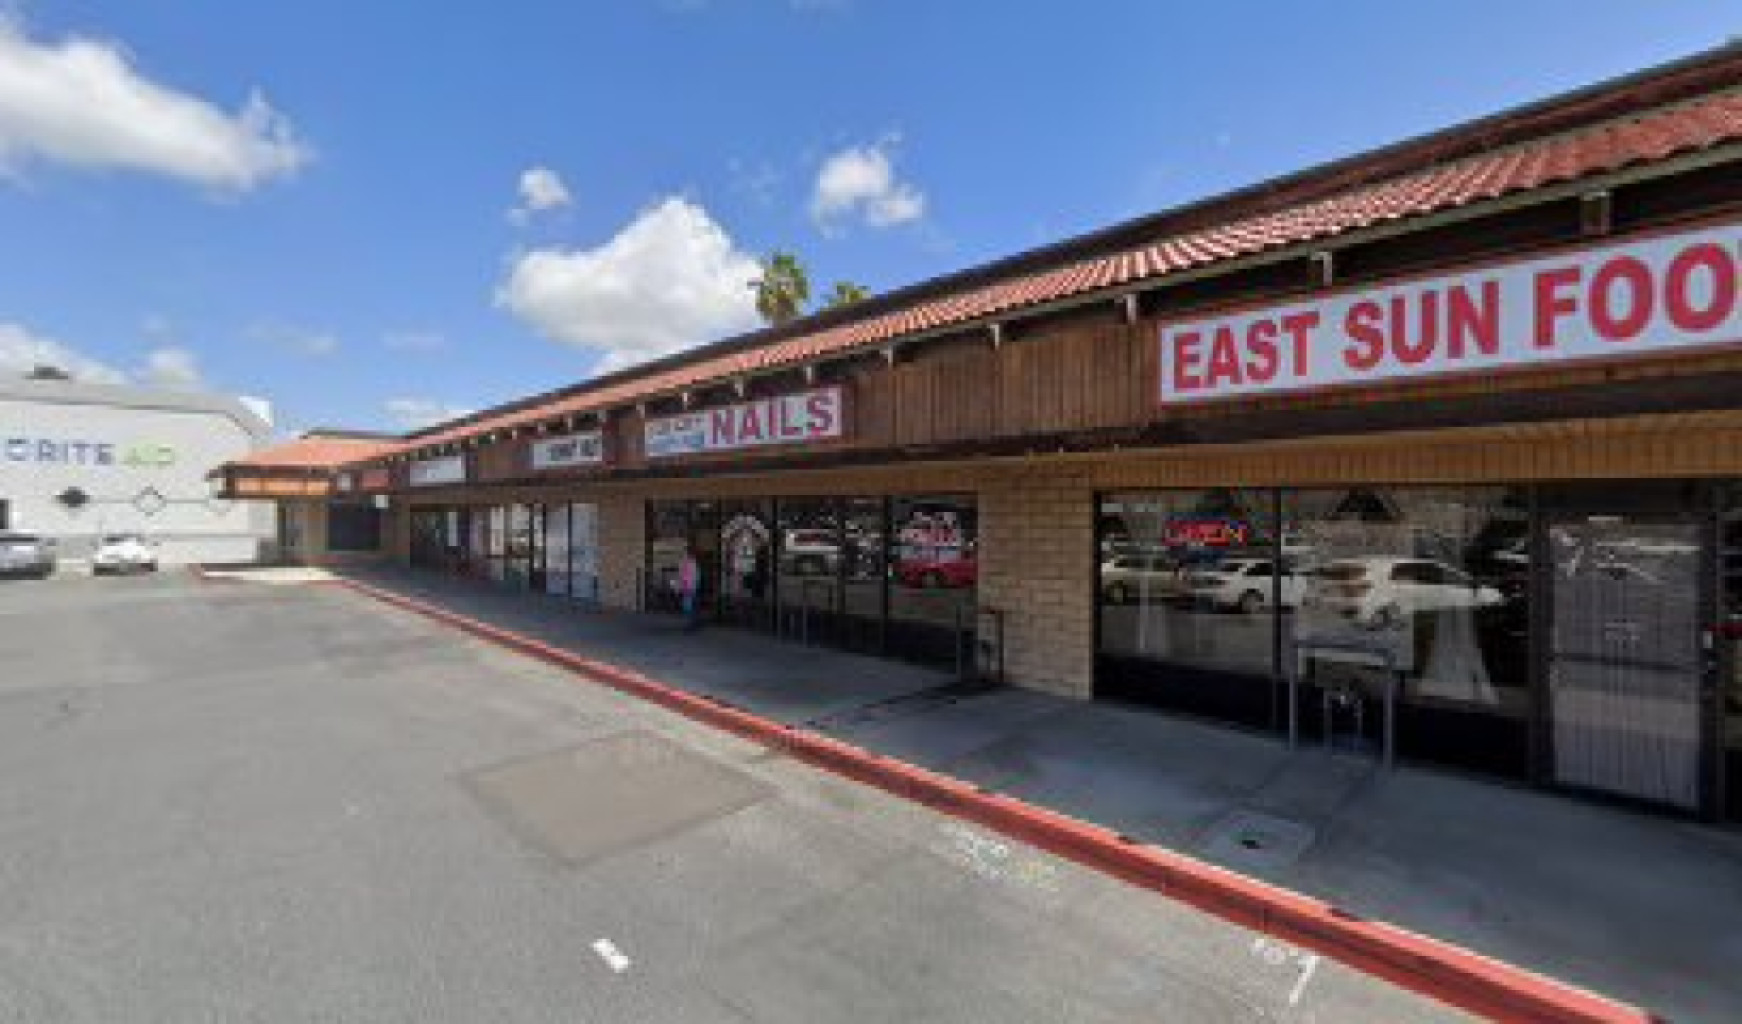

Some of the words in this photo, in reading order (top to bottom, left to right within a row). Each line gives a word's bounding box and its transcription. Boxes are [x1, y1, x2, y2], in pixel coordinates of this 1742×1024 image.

[1173, 311, 1320, 390] EAST
[1343, 280, 1500, 369] SUN
[1533, 242, 1740, 347] FOO
[709, 395, 833, 446] NAILS
[37, 438, 115, 465] RITE
